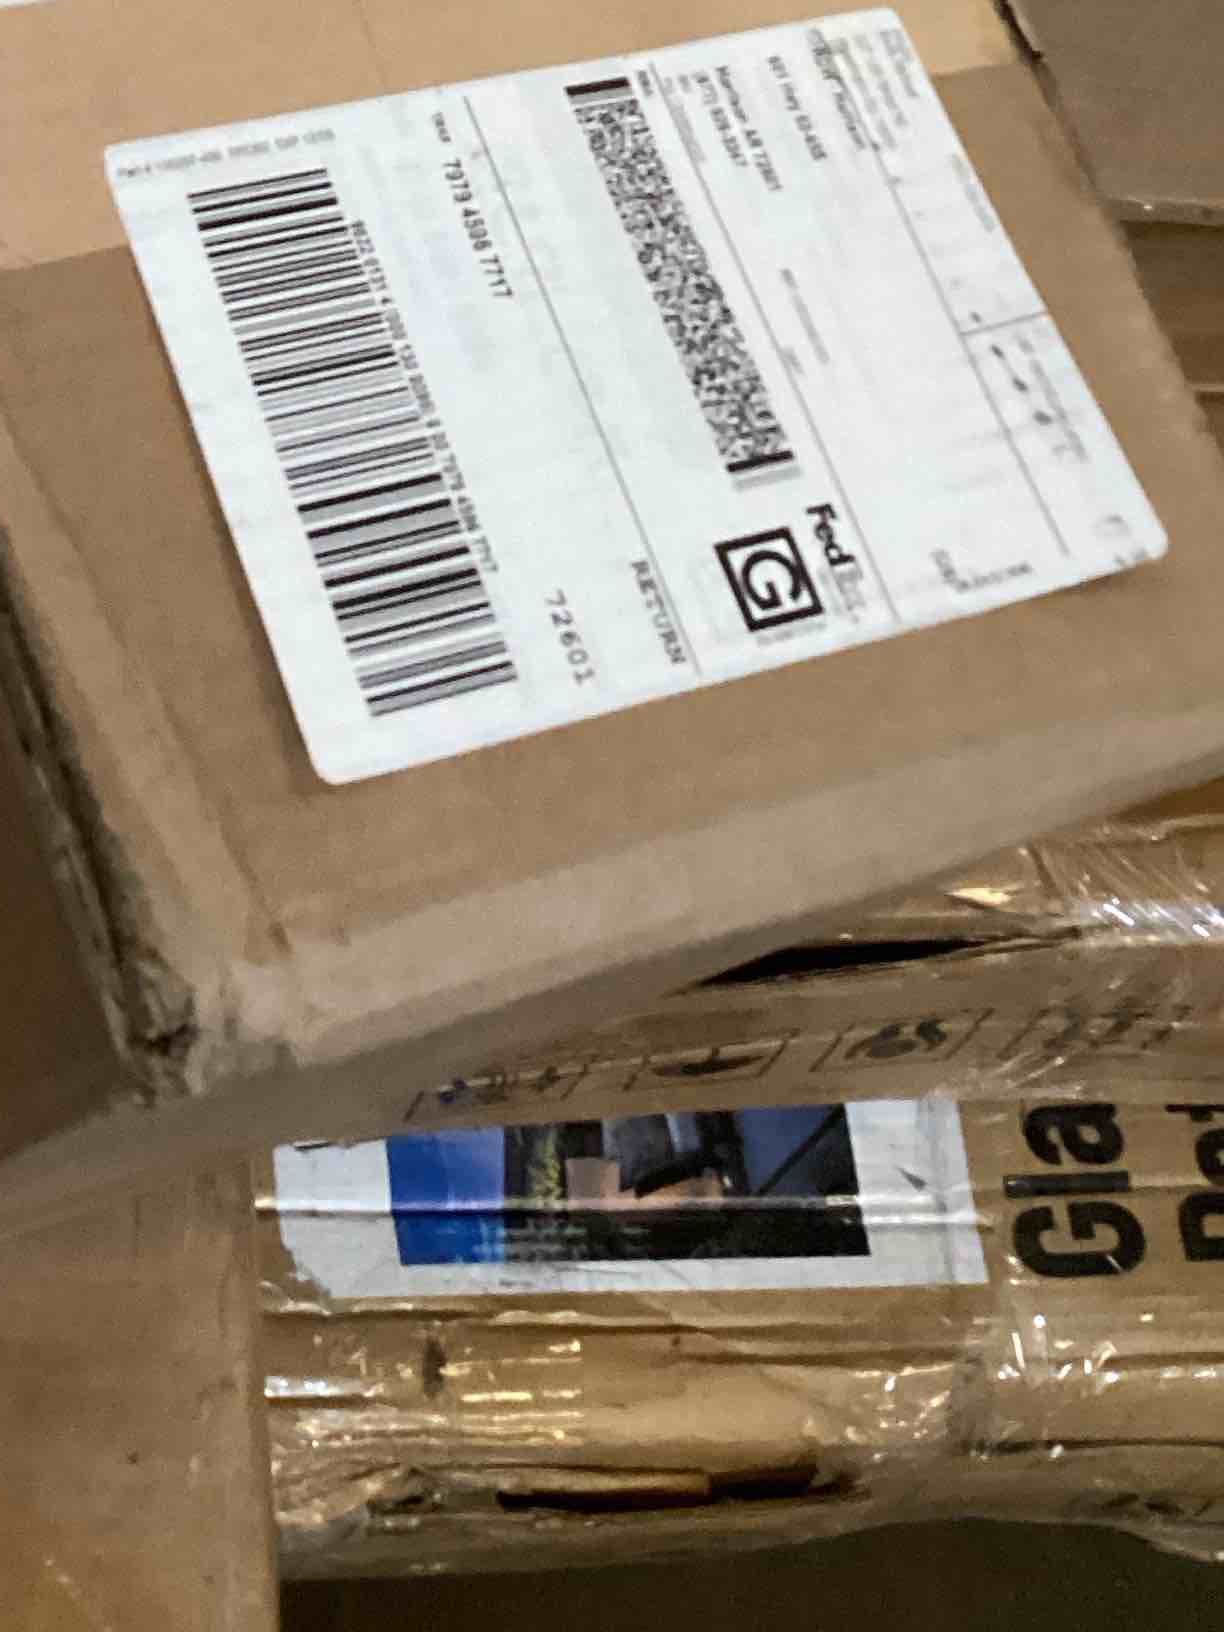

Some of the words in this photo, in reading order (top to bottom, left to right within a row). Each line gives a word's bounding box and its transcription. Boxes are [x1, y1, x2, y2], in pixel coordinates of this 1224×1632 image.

[479, 254, 515, 298] 7717
[546, 589, 596, 685] 72601
[631, 559, 687, 664] RETURN
